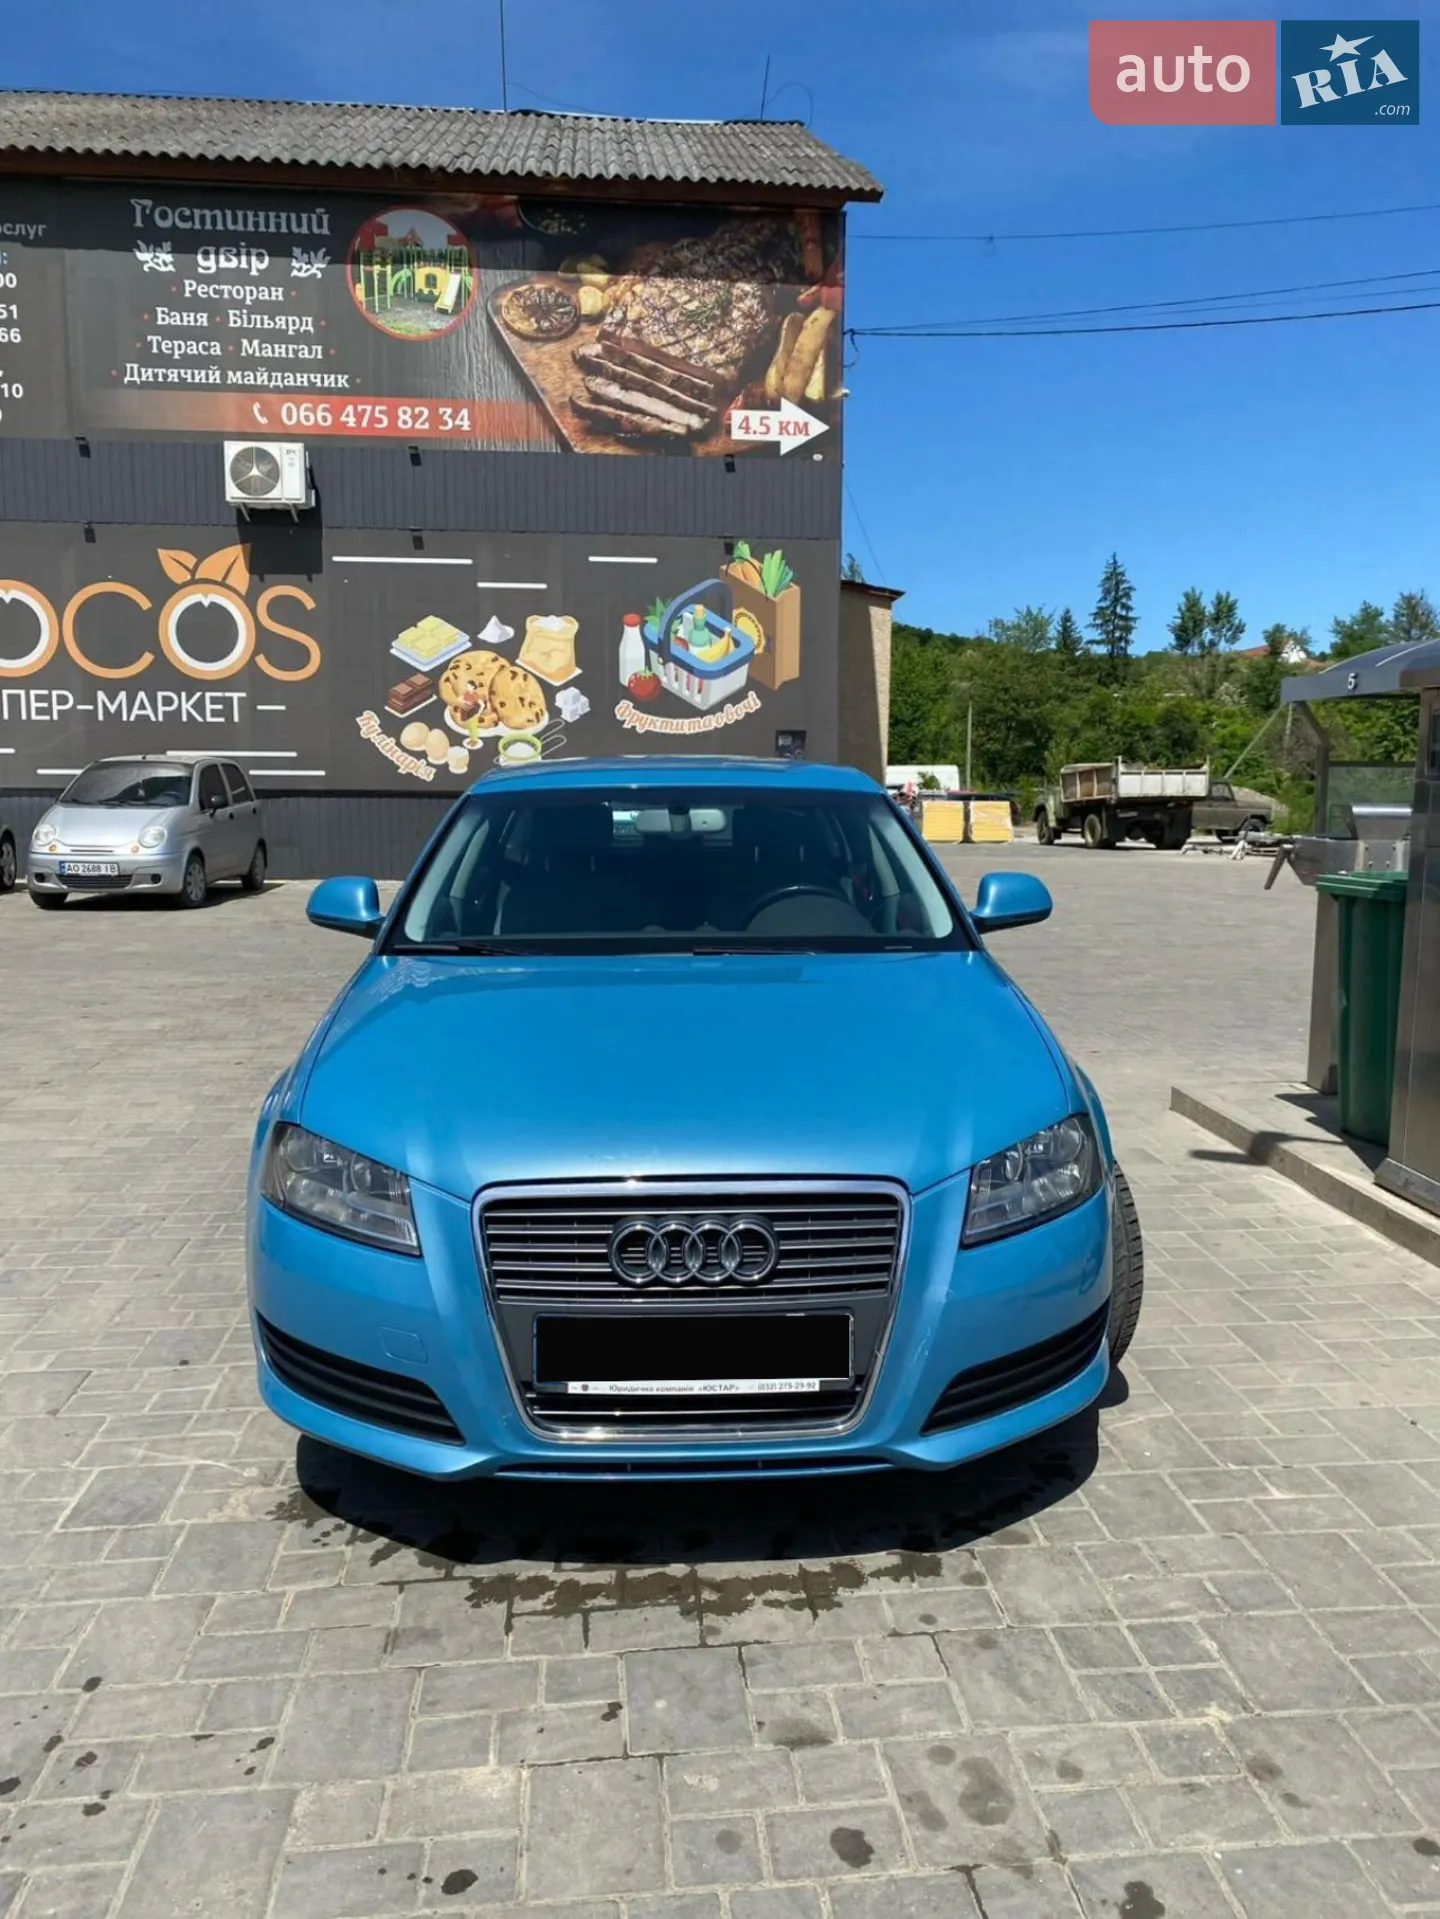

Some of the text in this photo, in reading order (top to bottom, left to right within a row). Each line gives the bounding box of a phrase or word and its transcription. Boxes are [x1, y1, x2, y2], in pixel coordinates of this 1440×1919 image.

[130, 198, 331, 236] Гостинний
[0, 223, 47, 240] слуг
[197, 241, 269, 276] двір
[184, 279, 284, 305] Ресторан
[155, 306, 314, 334] Баня Більярд
[147, 335, 323, 359] Тераса Мангал
[124, 363, 350, 389] Дитячий майданчик
[281, 402, 471, 431] 066 475 82 34
[737, 415, 771, 435] 4.5
[2, 689, 247, 723] ПЕР-МАРКЕТ
